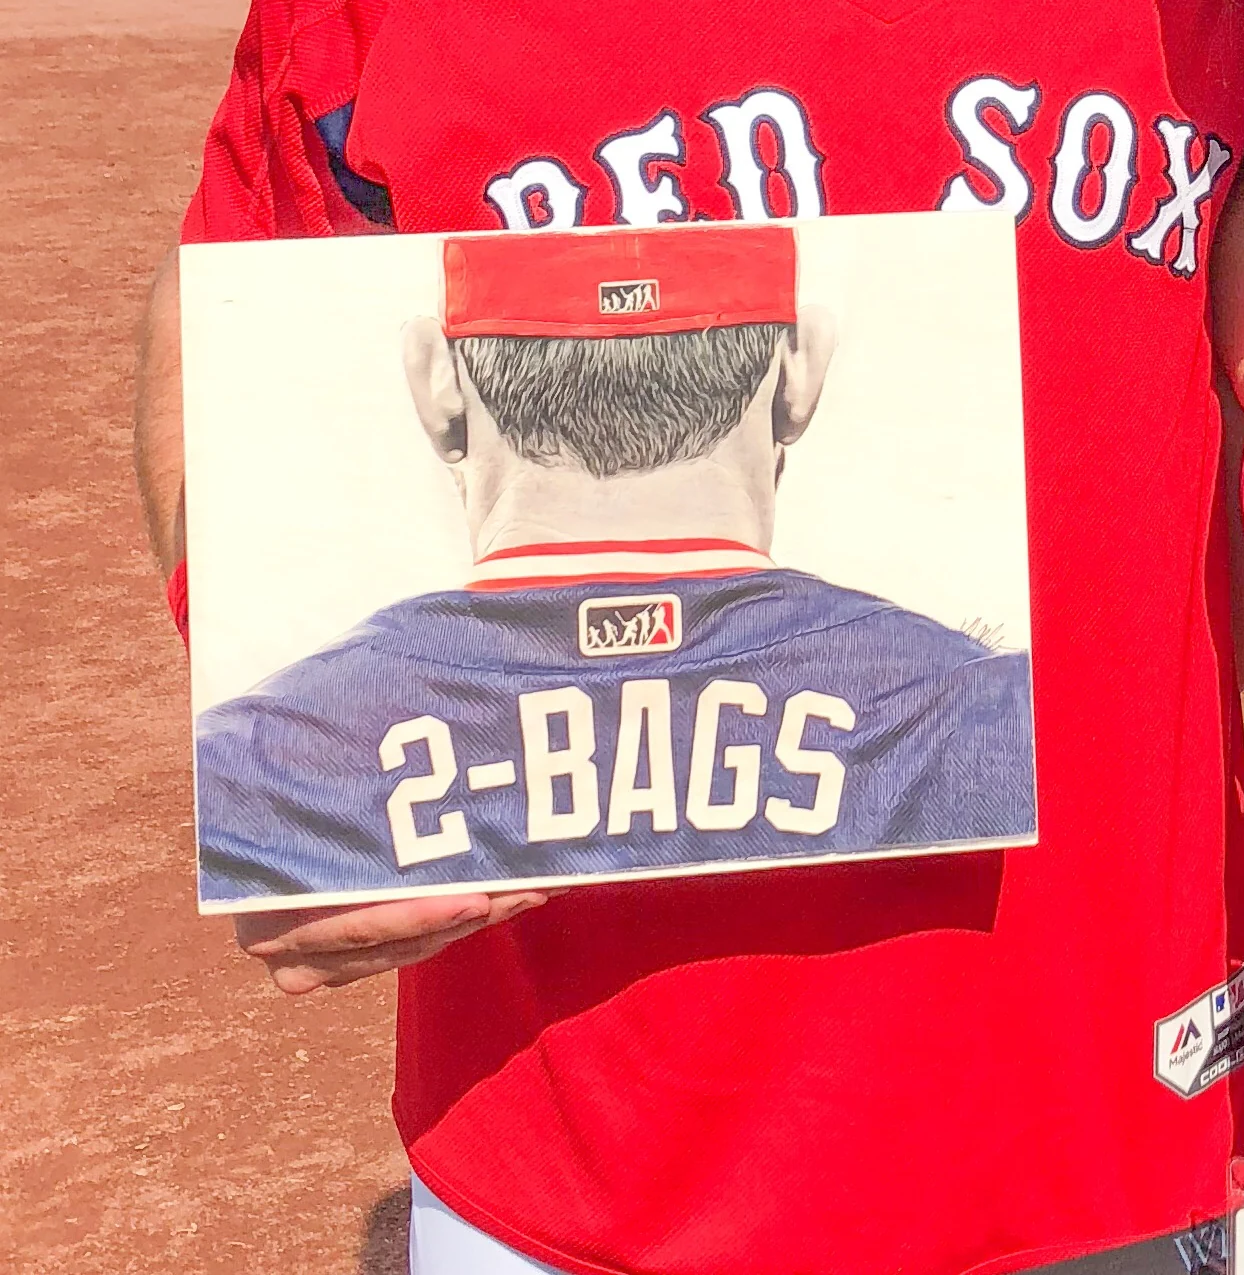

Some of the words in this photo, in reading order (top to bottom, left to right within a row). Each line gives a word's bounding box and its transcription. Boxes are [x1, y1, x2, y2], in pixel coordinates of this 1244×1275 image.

[940, 74, 1234, 280] SOX
[377, 677, 858, 868] 2-BAGS
[1168, 1038, 1204, 1070] Majestic
